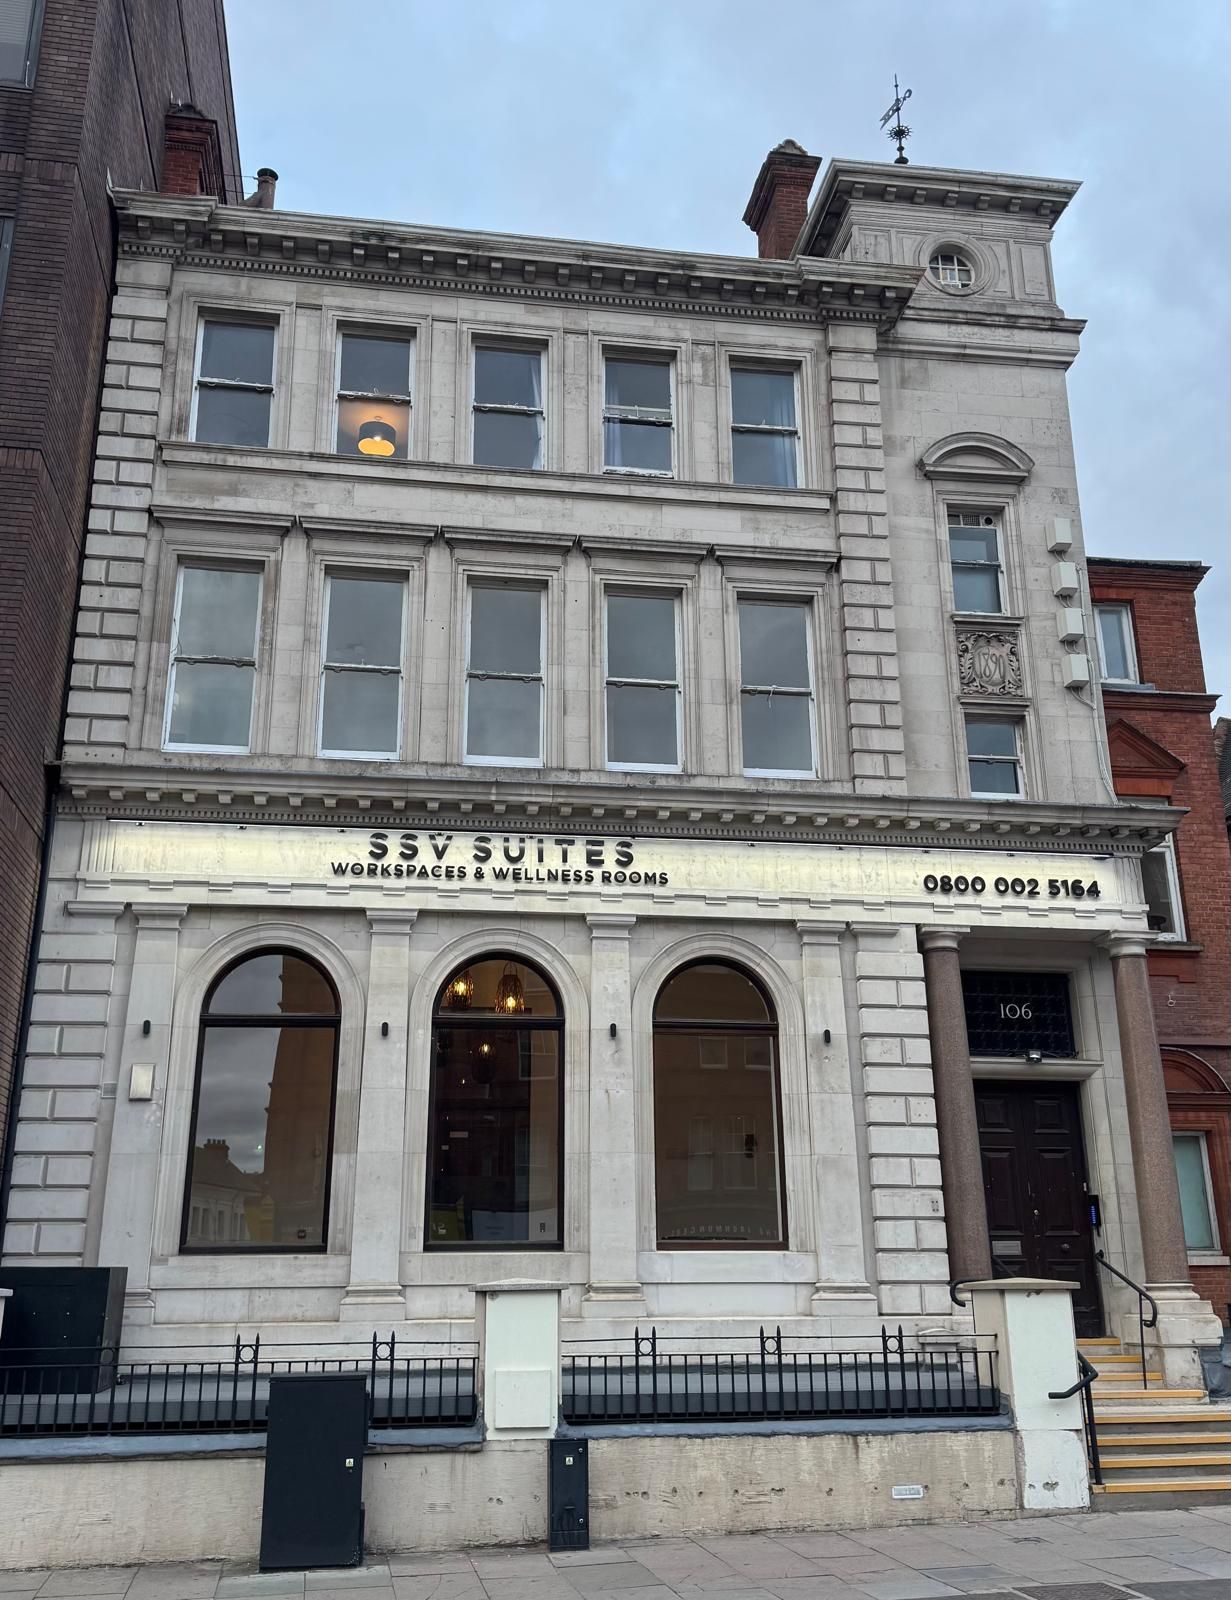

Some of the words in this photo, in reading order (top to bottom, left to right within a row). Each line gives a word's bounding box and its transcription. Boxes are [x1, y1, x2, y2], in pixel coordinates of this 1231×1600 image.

[977, 647, 1006, 683] 1890
[368, 832, 453, 860] SSV
[472, 835, 635, 867] SUITES
[331, 861, 467, 879] WORKSPACES
[473, 868, 485, 879] &
[492, 866, 595, 883] WELLNESS
[601, 870, 669, 885] ROOMS
[923, 874, 986, 893] 0800
[994, 876, 1041, 896] 002
[1047, 878, 1101, 898] 5164
[1000, 1002, 1033, 1020] 106
